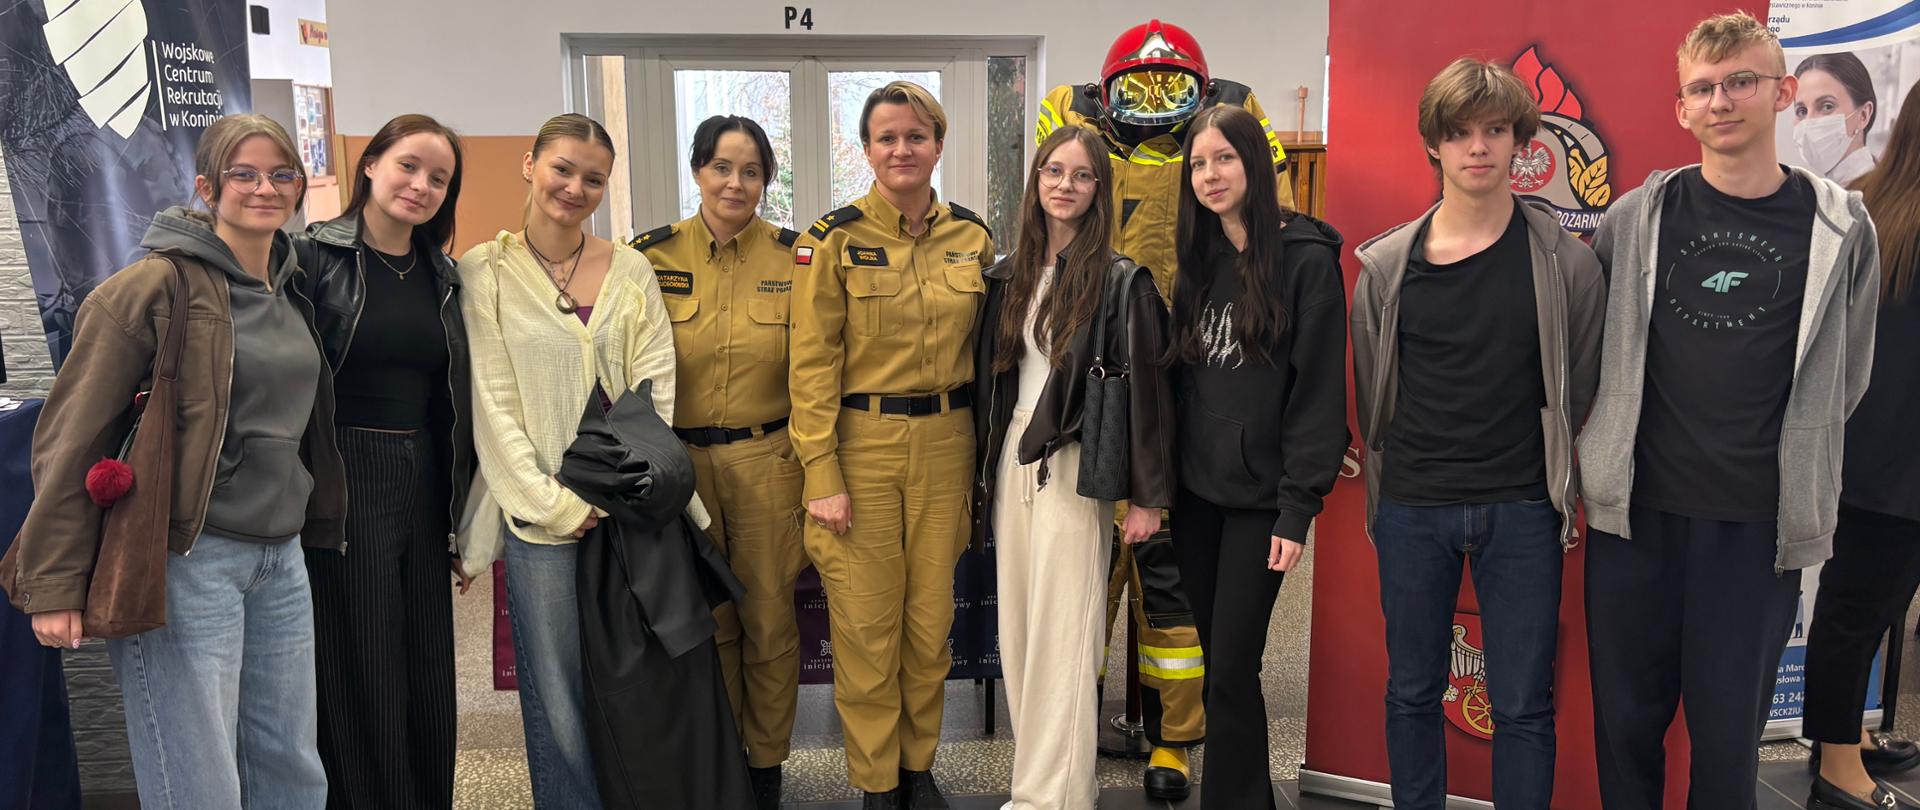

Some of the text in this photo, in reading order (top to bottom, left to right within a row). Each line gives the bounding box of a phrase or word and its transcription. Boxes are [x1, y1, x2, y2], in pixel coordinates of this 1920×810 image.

[784, 6, 814, 30] P4
[161, 41, 215, 64] Wojskowe
[164, 64, 214, 84] Centrum
[166, 86, 223, 110] Rekrutacji
[169, 113, 179, 127] w
[1701, 270, 1749, 293] 4F
[1773, 693, 1785, 704] 63
